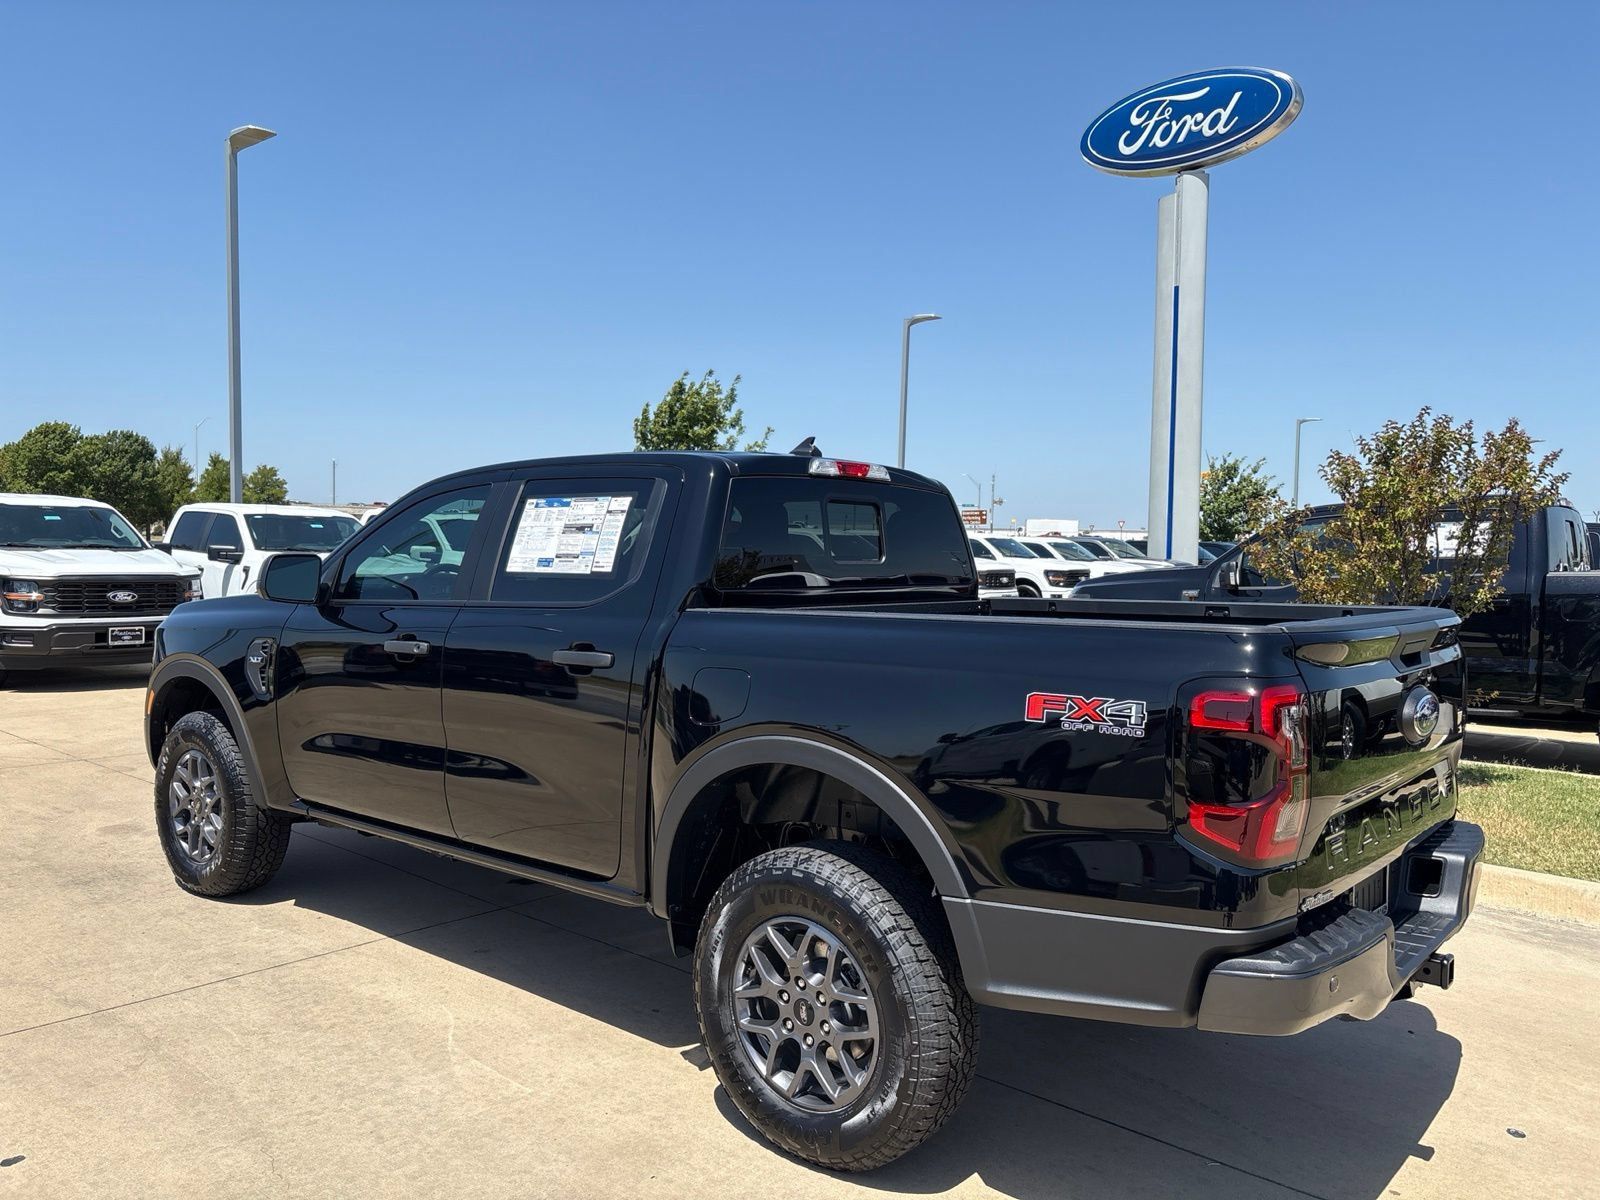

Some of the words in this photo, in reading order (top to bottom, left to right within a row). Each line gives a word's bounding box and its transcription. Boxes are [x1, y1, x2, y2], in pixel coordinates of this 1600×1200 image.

[1118, 86, 1243, 156] Ford
[115, 591, 133, 600] Ford
[1024, 692, 1148, 729] FX4
[1061, 721, 1094, 732] OFF
[1099, 724, 1146, 738] ROAD
[1325, 768, 1454, 870] RANGER
